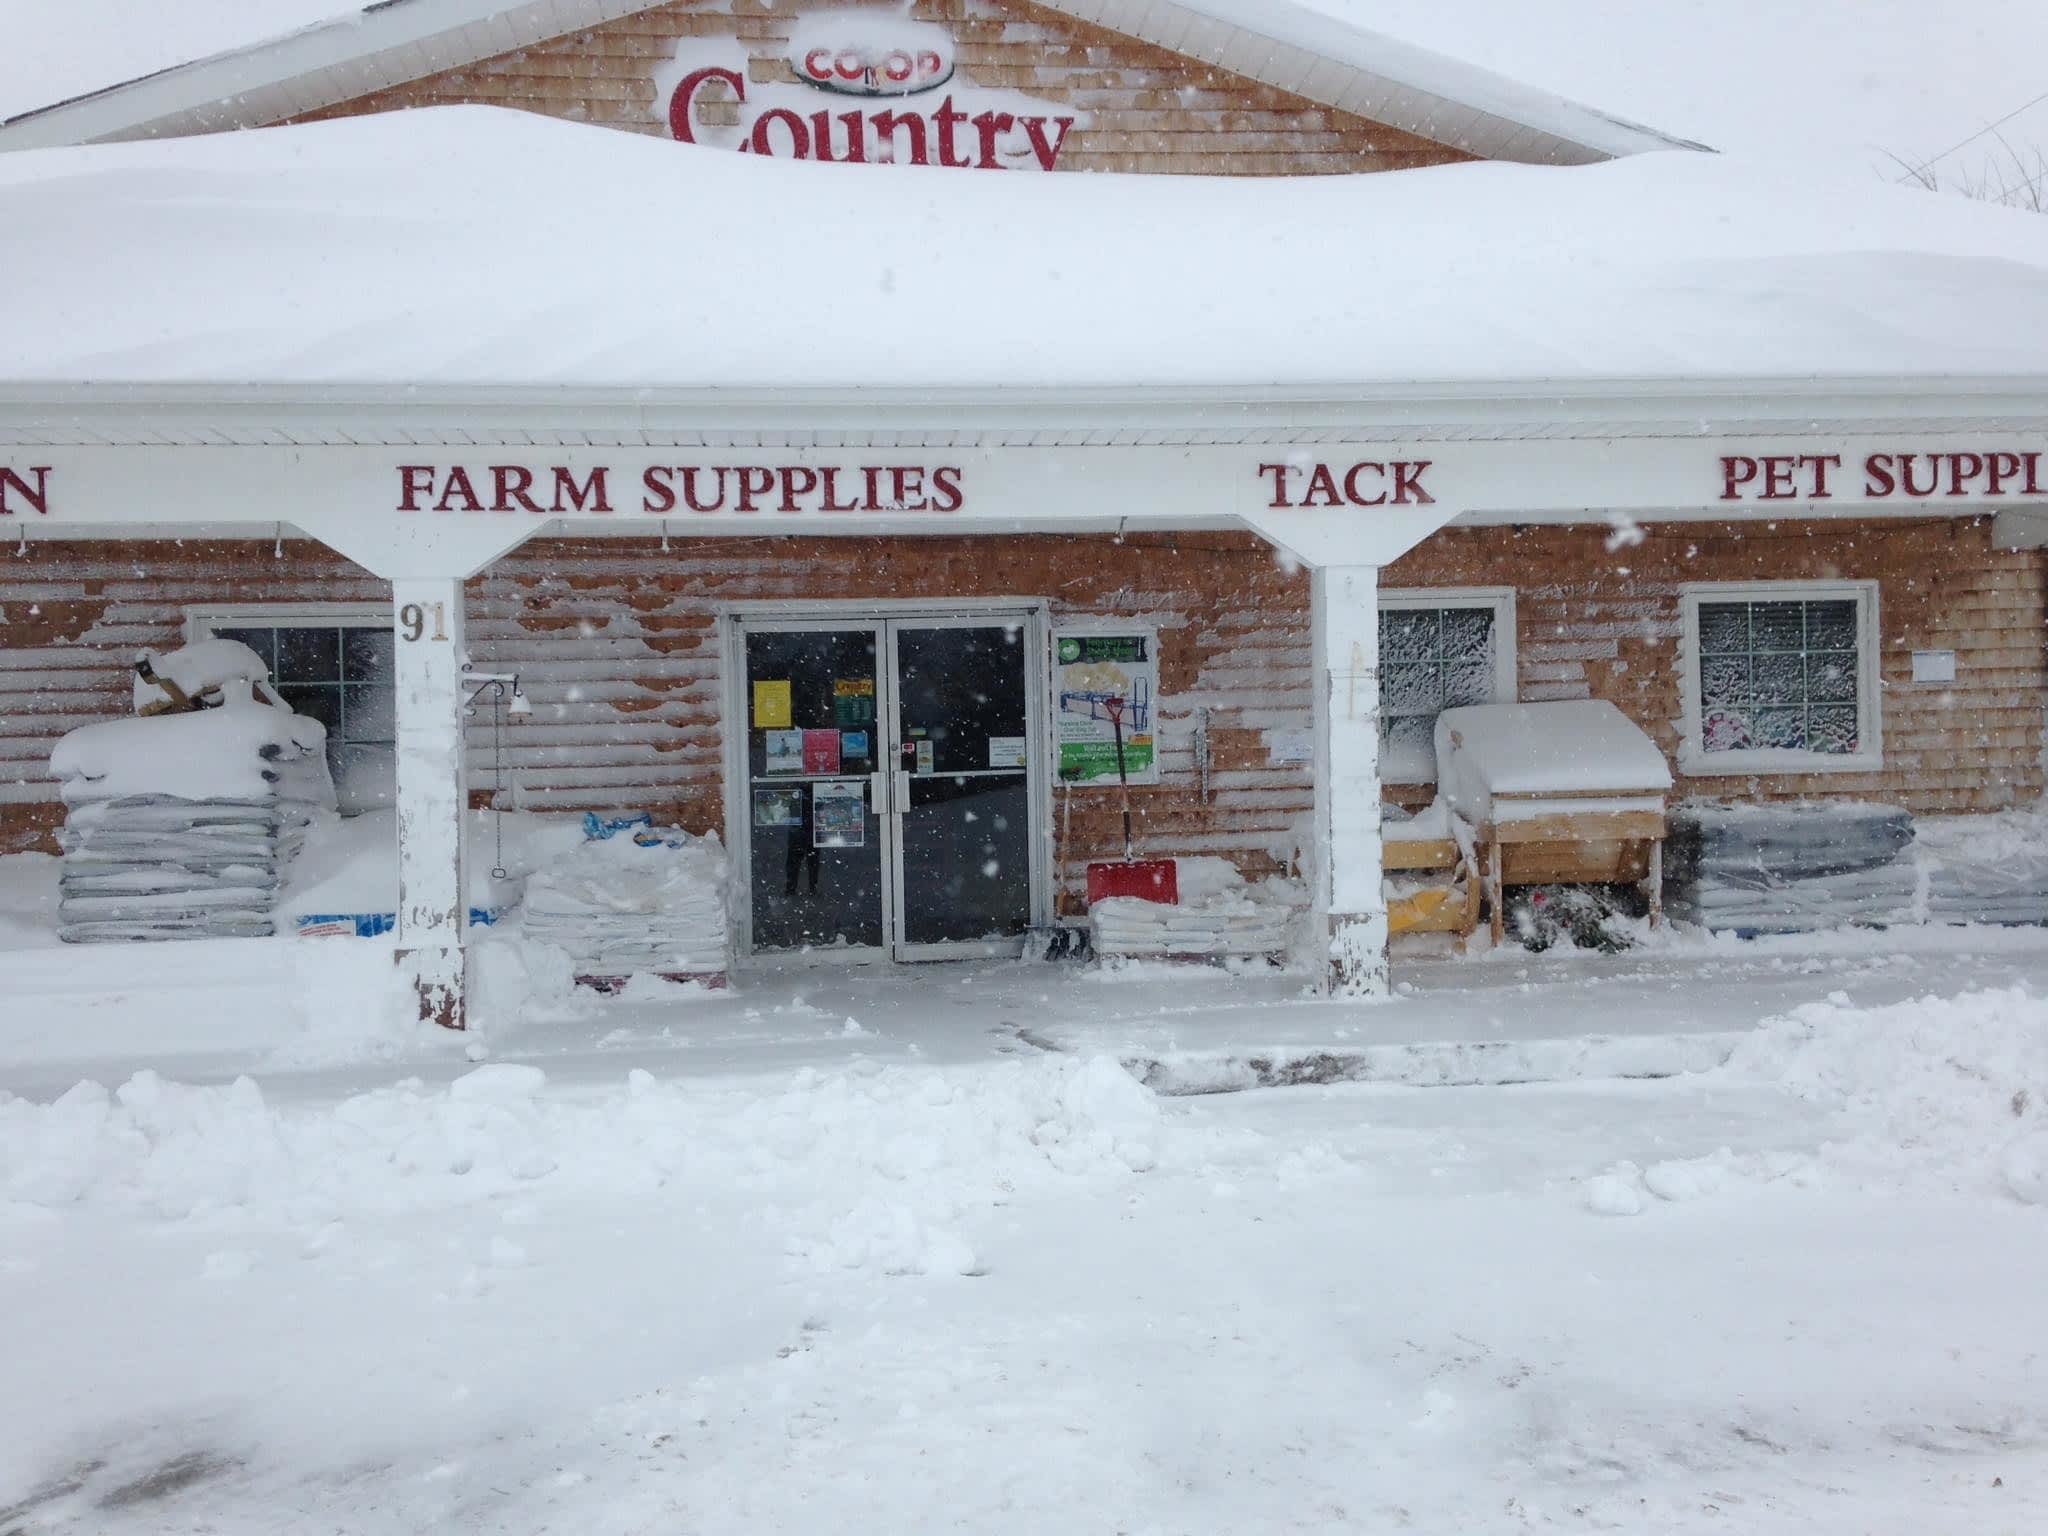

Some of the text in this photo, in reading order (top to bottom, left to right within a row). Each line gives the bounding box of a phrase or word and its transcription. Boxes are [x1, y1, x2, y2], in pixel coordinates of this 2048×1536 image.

[669, 67, 1074, 172] Country
[396, 465, 963, 513] FARM SUPPLIES
[1258, 461, 1436, 507] TACK
[1720, 454, 1841, 499] PET
[401, 603, 449, 643] 91
